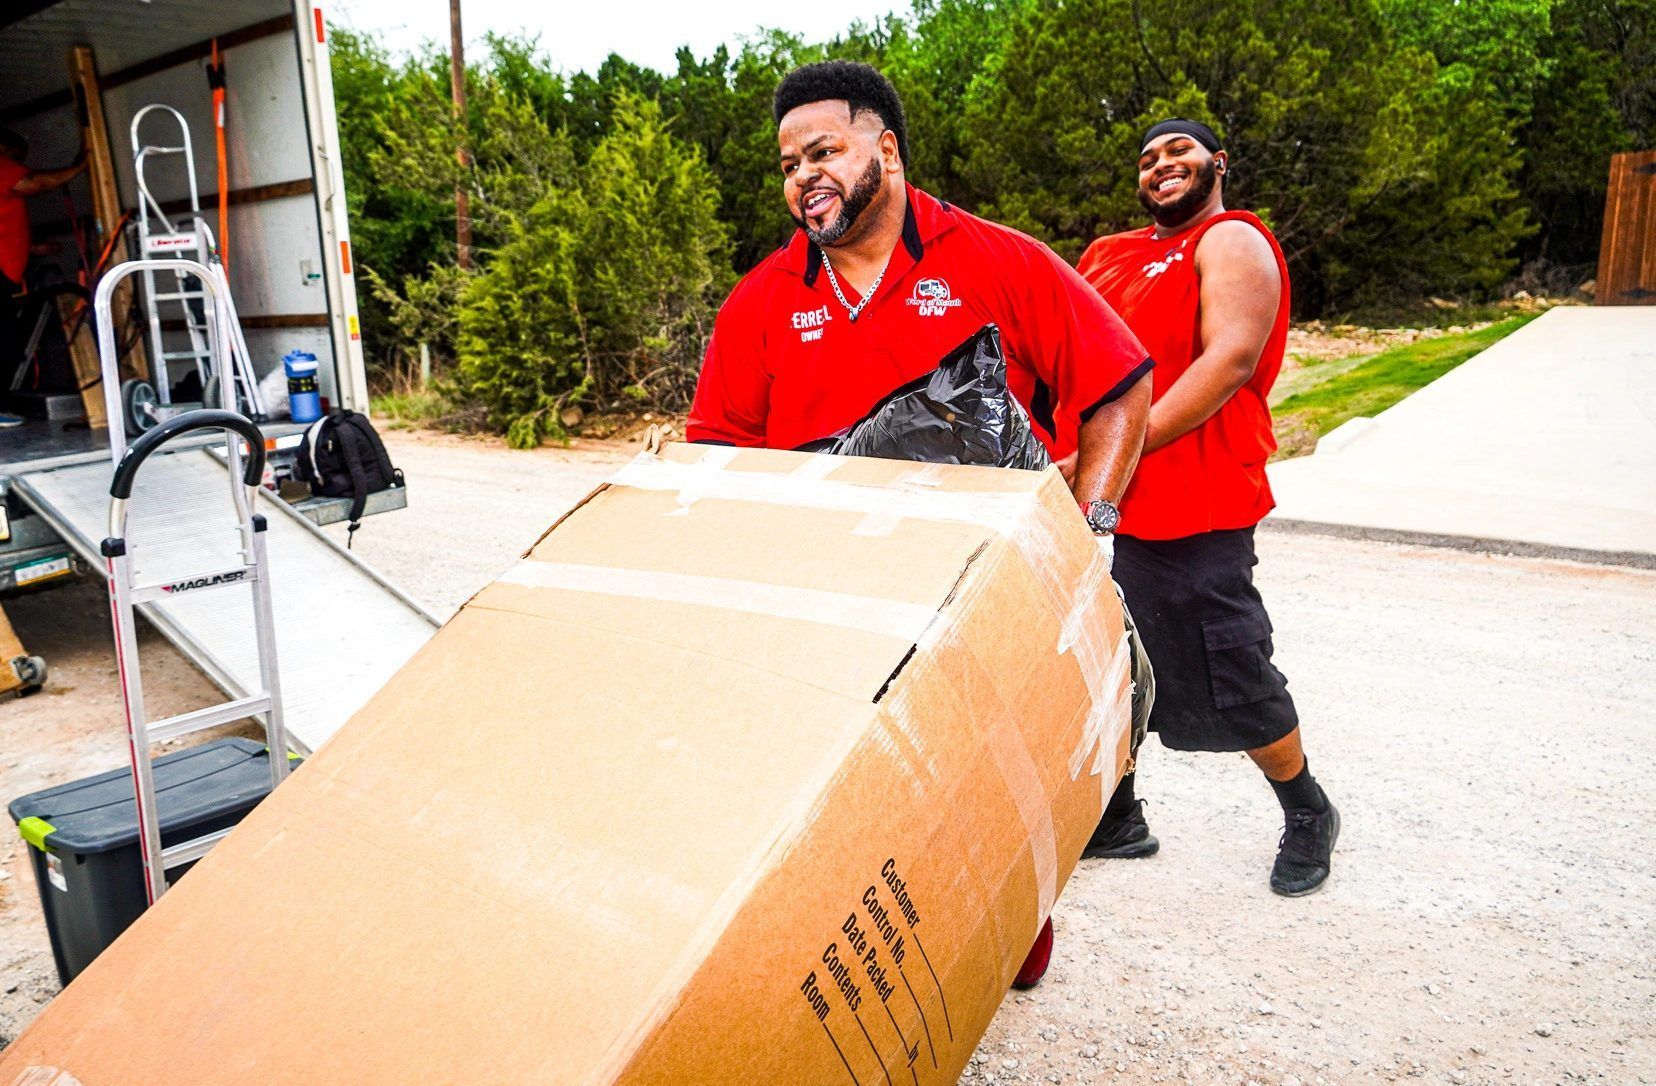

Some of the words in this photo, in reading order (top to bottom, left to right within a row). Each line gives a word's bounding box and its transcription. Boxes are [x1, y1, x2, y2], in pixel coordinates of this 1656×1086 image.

[801, 328, 823, 342] OWNE
[919, 306, 947, 316] DFW
[171, 570, 245, 593] MAGLINER
[881, 858, 920, 929] Customer
[862, 885, 898, 945] Control
[890, 936, 905, 969] No.
[822, 942, 862, 1012] Contents
[842, 912, 867, 956] Date
[862, 946, 895, 1003] Packed
[800, 971, 831, 1022] Room
